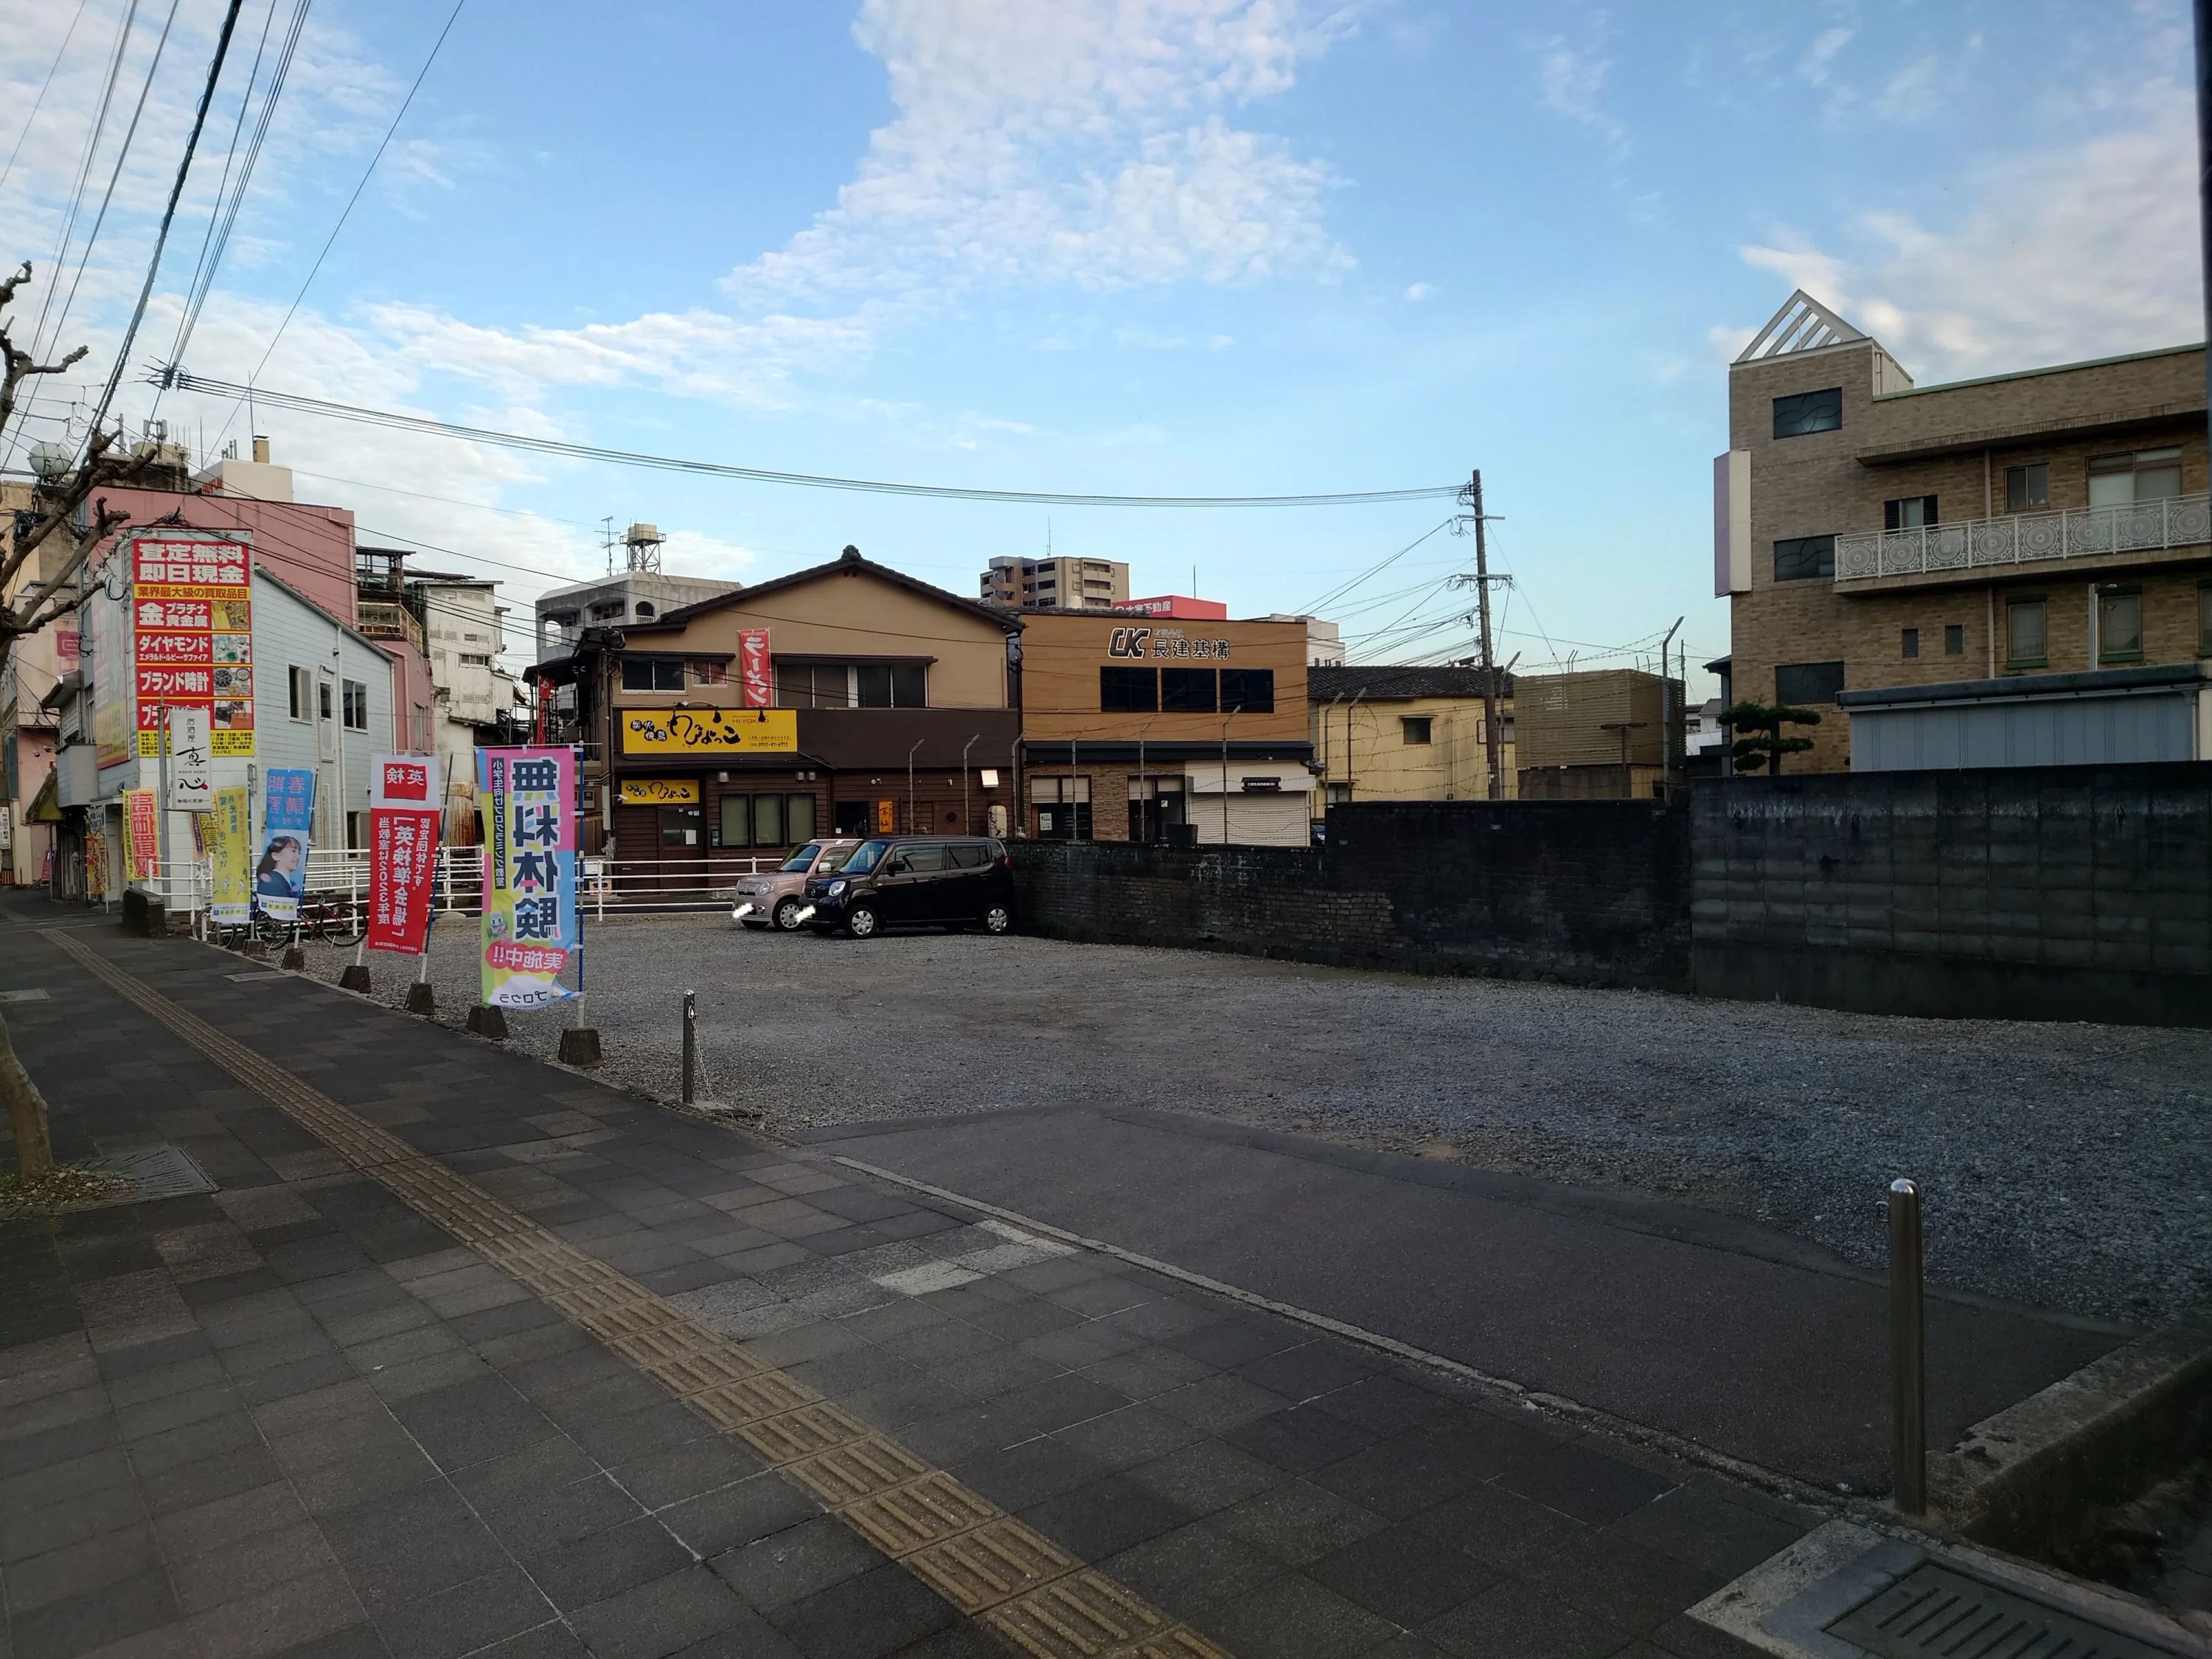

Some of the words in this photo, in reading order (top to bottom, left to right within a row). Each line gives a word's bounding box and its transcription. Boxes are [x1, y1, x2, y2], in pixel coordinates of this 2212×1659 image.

[139, 542, 245, 564] 査定無料
[139, 563, 245, 583] 即日現金
[138, 586, 248, 599] 業界最大級の買取品目
[138, 602, 164, 626] 金
[166, 602, 207, 614] プラチナ
[166, 614, 208, 627] 貴金属
[139, 635, 209, 653] ダイヤモンド
[1152, 639, 1231, 661] 長建基構
[139, 670, 209, 692] ブランド時計
[744, 636, 768, 704] ラーメン
[187, 718, 195, 742] 居酒屋
[130, 792, 161, 877] 高価買取
